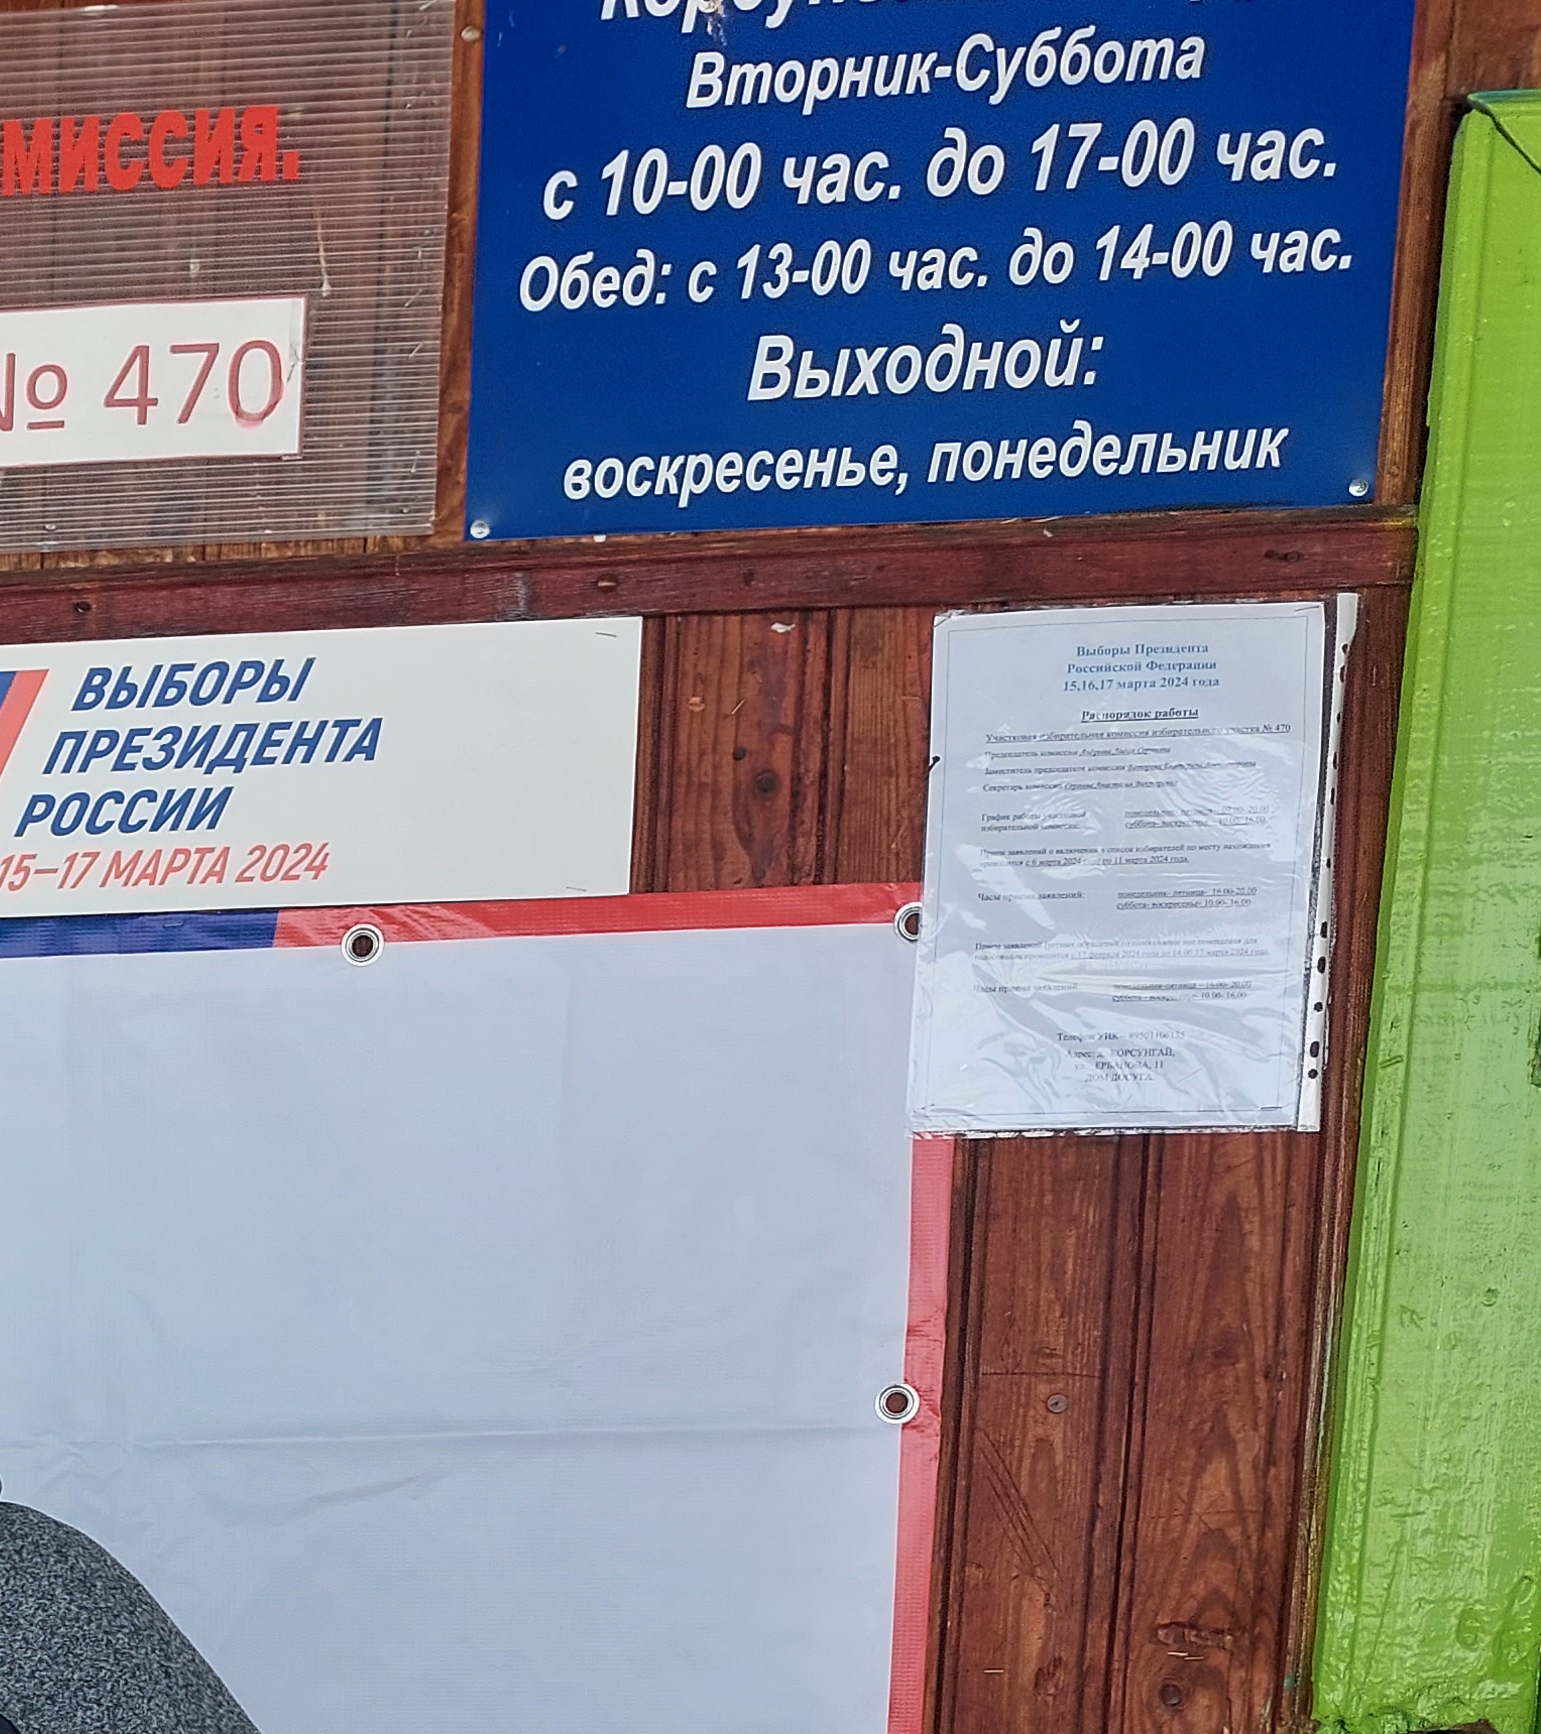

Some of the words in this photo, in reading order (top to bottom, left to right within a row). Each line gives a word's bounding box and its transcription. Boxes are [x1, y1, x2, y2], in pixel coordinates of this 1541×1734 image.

[686, 25, 1204, 115] Вторник-Суббота
[544, 171, 577, 220] с
[602, 143, 761, 215] 10-00
[783, 152, 900, 204] час.
[927, 128, 1004, 196] до
[1032, 118, 1194, 190] 17-00
[1217, 129, 1336, 181] час.
[520, 249, 671, 311] Обед:
[689, 261, 716, 302] с
[737, 239, 871, 298] 13-00
[889, 247, 987, 290] час.
[1010, 228, 1073, 285] до
[1096, 220, 1232, 280] 14-00
[1251, 229, 1351, 272] час.
[748, 319, 1103, 400] Выходной:
[100, 338, 284, 432] 470
[564, 445, 908, 507] воскресенье,
[928, 420, 1289, 482] понедельник
[1067, 660, 1142, 674] Российской
[1077, 645, 1130, 658] Выборы
[1135, 644, 1209, 656] Президента
[74, 661, 313, 711] ВЫБОРЫ
[1116, 680, 1156, 691] марта
[1160, 677, 1189, 688] 2024
[1192, 678, 1220, 688] года
[1155, 708, 1199, 720] работы
[1275, 723, 1291, 733] 470
[45, 719, 381, 774] ПРЕЗИДЕНТА
[15, 787, 231, 835] РОССИИ
[102, 847, 229, 887] МАРТА
[236, 843, 328, 883] 2024
